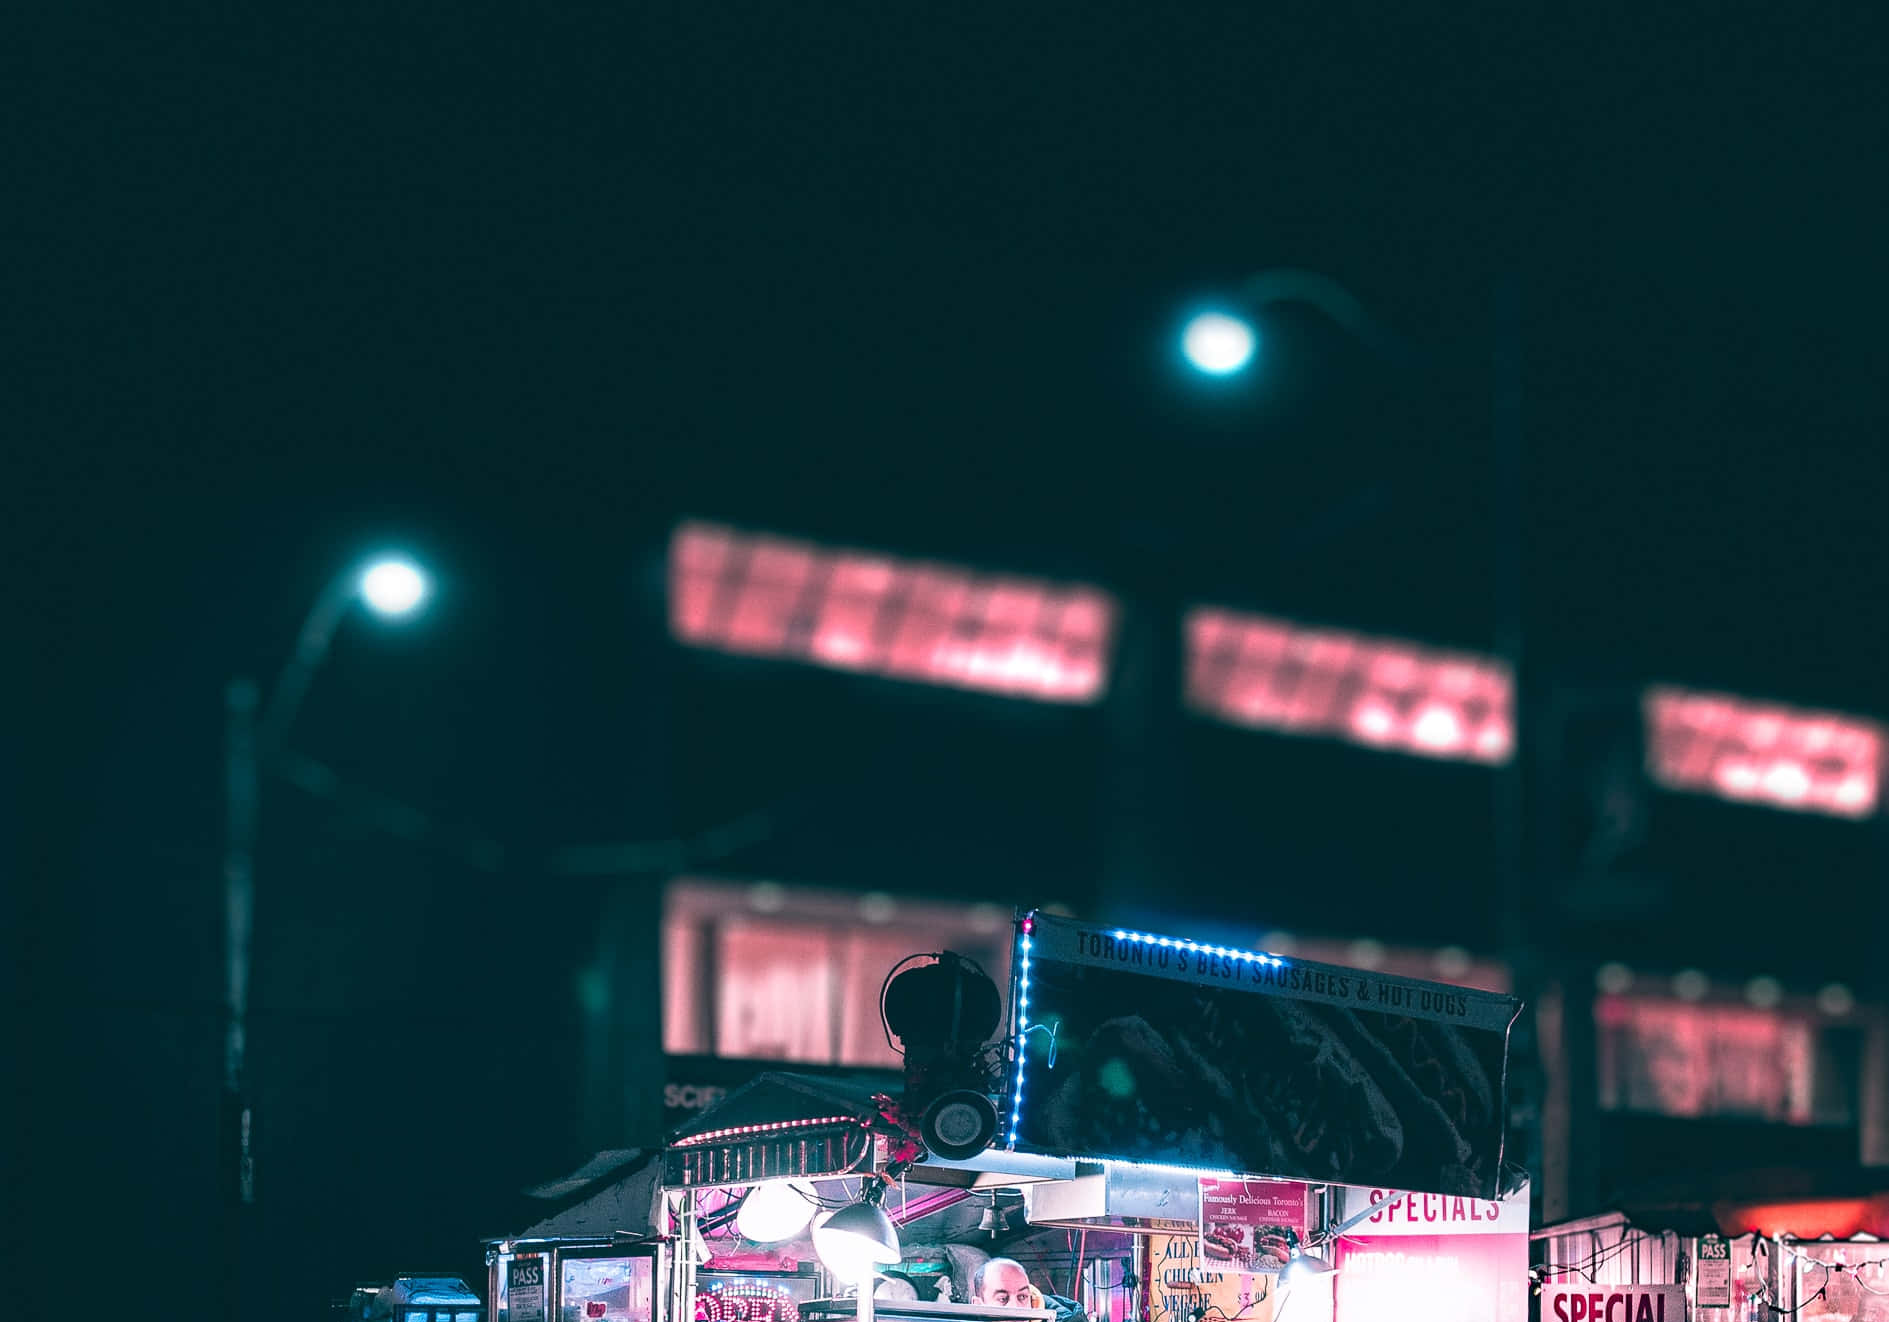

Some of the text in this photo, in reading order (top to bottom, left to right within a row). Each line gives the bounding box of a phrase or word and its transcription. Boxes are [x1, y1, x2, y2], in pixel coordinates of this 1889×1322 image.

[1077, 930, 1467, 1017] TORONTO'S BEST SAUSAGES & HOT DOGS
[1203, 1193, 1238, 1206] Famously
[1240, 1195, 1271, 1206] Delicious
[1369, 1189, 1500, 1223] SPECIALS
[1701, 1243, 1727, 1259] PASS
[512, 1266, 539, 1285] PASS
